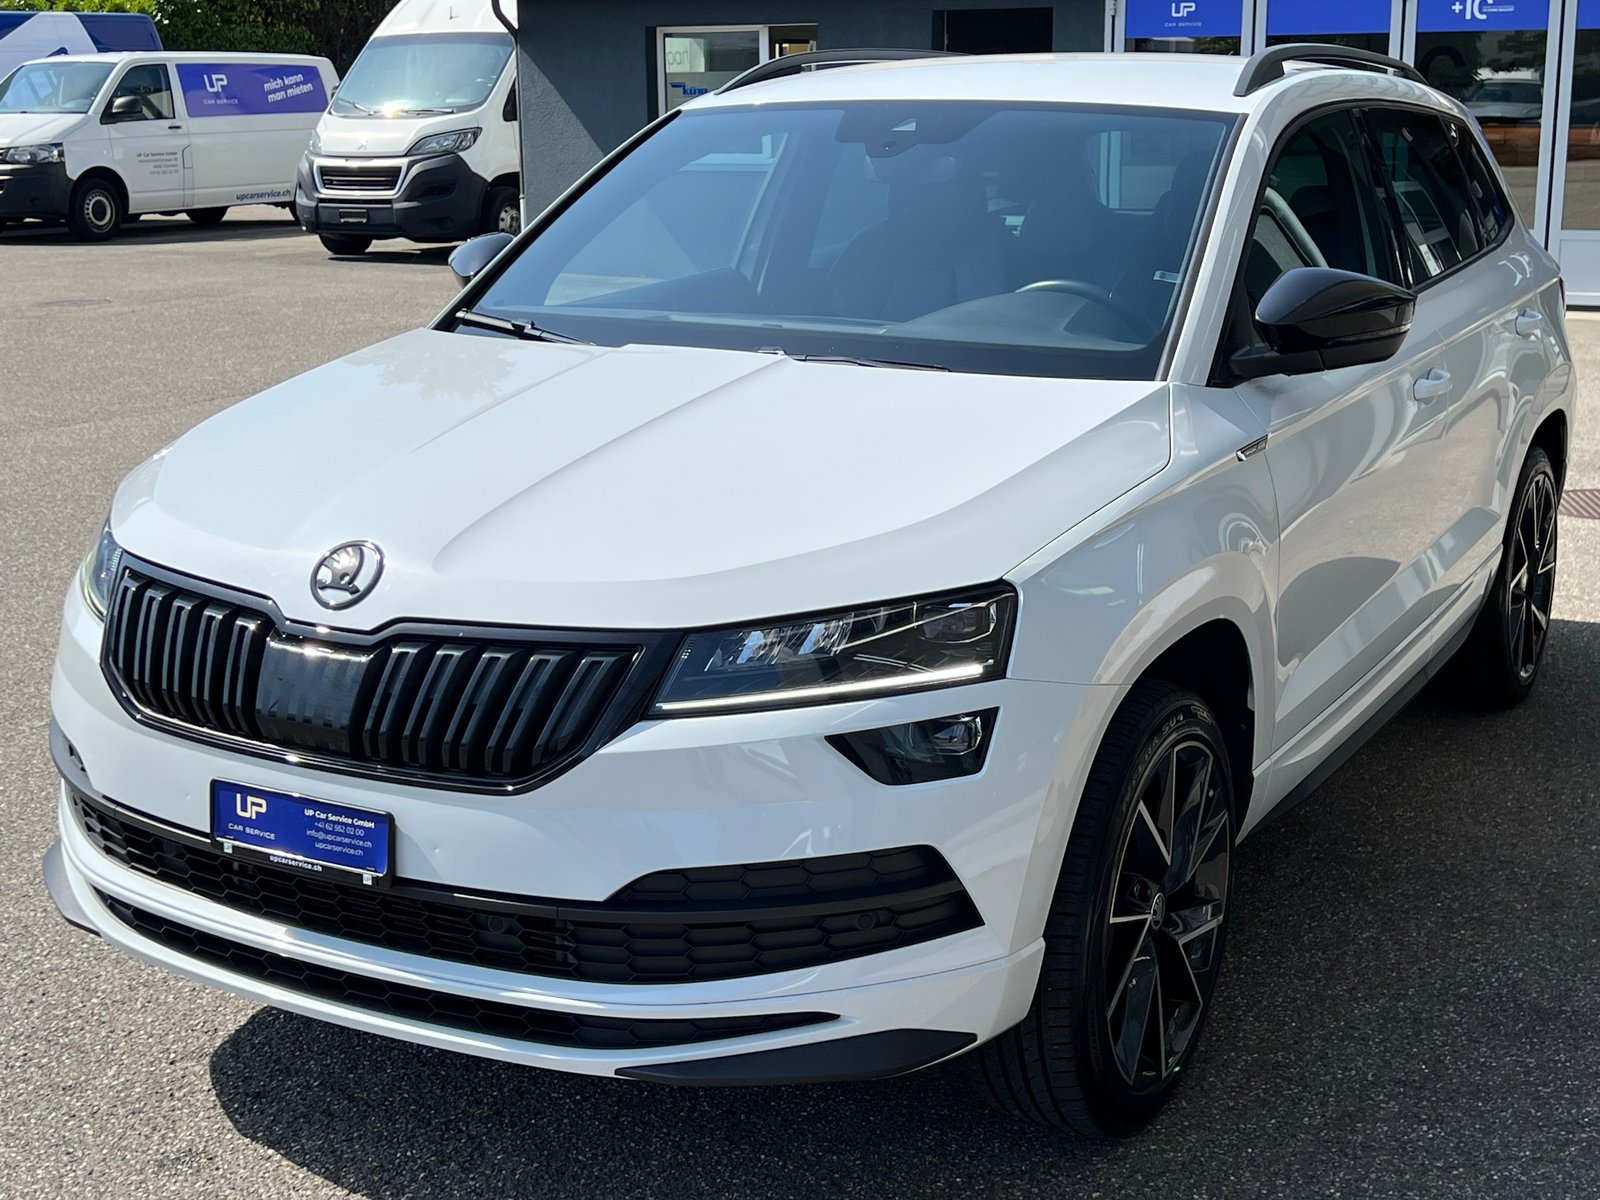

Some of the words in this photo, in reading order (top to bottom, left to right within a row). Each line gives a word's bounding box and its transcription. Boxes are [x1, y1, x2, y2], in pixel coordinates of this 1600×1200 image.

[1171, 2, 1196, 17] UP
[203, 74, 228, 92] UP
[264, 78, 284, 91] mich
[284, 73, 304, 85] kann
[267, 90, 287, 103] man
[287, 83, 314, 97] mieten
[236, 189, 291, 201] upcarservice.ch
[236, 793, 267, 819] UP
[304, 809, 314, 817] UP
[315, 811, 327, 820] Car
[328, 813, 352, 824] Service
[353, 818, 375, 829] GmbH
[228, 823, 243, 832] CAR
[245, 826, 276, 840] SERVICE
[306, 828, 372, 848] info@upcarservice.ch
[355, 828, 365, 837] 00
[315, 841, 363, 856] upcarservice.ch
[269, 854, 323, 872] upcarservice.ch
